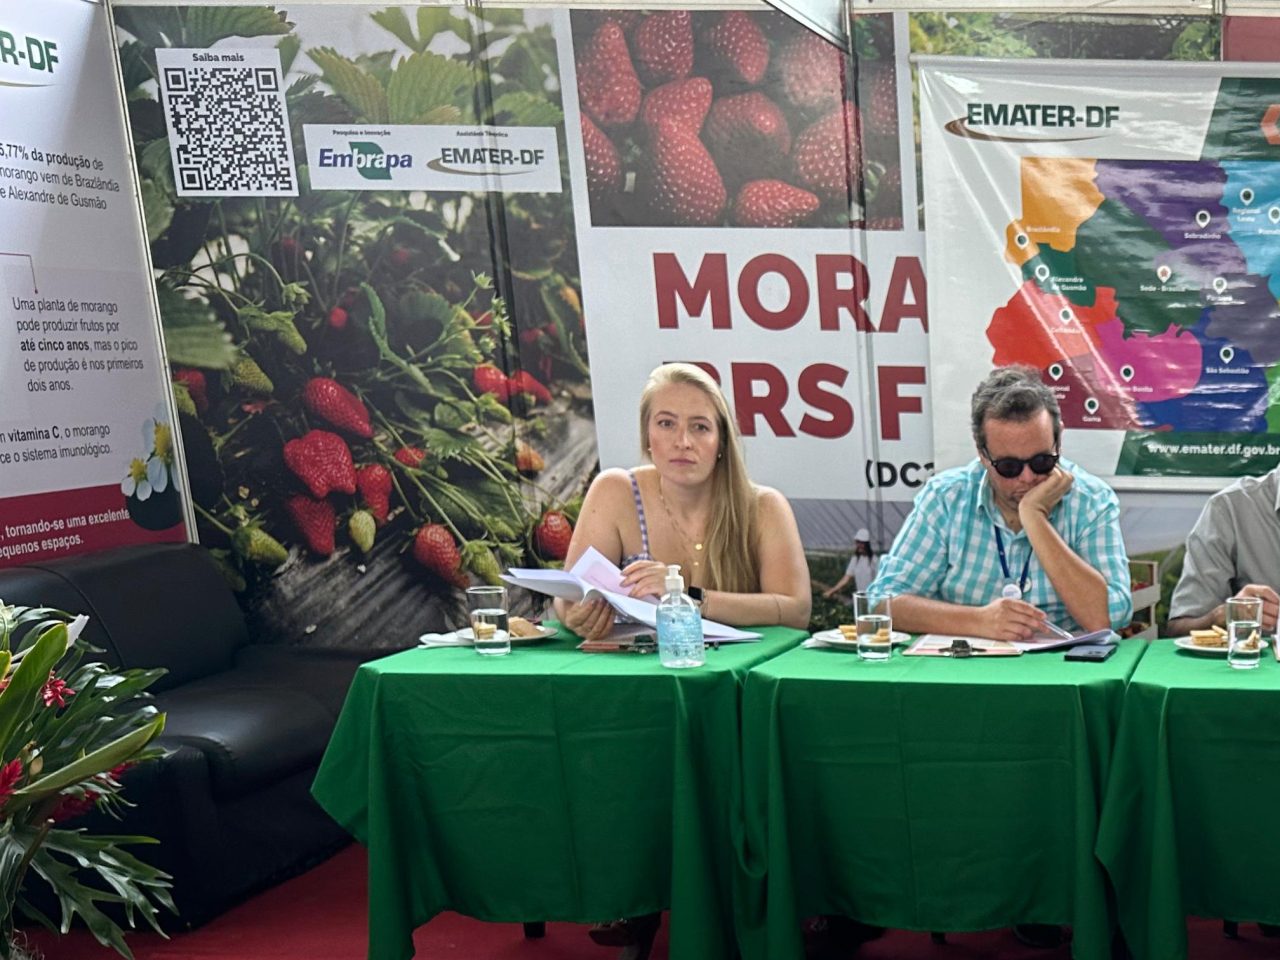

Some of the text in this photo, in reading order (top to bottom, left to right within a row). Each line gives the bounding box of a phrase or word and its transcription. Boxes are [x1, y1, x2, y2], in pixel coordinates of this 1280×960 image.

[192, 52, 245, 62] Saiba mais
[967, 103, 1120, 128] EMATER-DF
[31, 148, 44, 162] da
[46, 152, 91, 171] produção
[92, 158, 104, 171] de
[319, 148, 413, 168] Embrapa
[441, 147, 545, 166] EMATER-DF
[40, 171, 60, 185] vem
[62, 173, 73, 186] de
[75, 174, 120, 193] Brazlândia
[8, 185, 55, 205] Alexandre
[58, 193, 69, 205] de
[70, 193, 107, 211] Gusmão
[652, 252, 929, 333] MORA
[12, 297, 118, 316] Uma planta de morango
[16, 319, 120, 334] pode produzir frutos por
[20, 338, 138, 353] até cinco anos, mas o pico
[24, 358, 144, 374] de produção é nos primeiros
[27, 379, 74, 392] dois anos.
[662, 361, 927, 440] RS F
[7, 426, 51, 442] vitamina
[64, 428, 71, 439] o
[72, 424, 111, 439] morango
[13, 452, 21, 463] o
[22, 447, 58, 462] sistema
[59, 442, 112, 459] imunológico.
[5, 507, 131, 538] tornando-se uma excelente
[41, 533, 84, 552] espaços.
